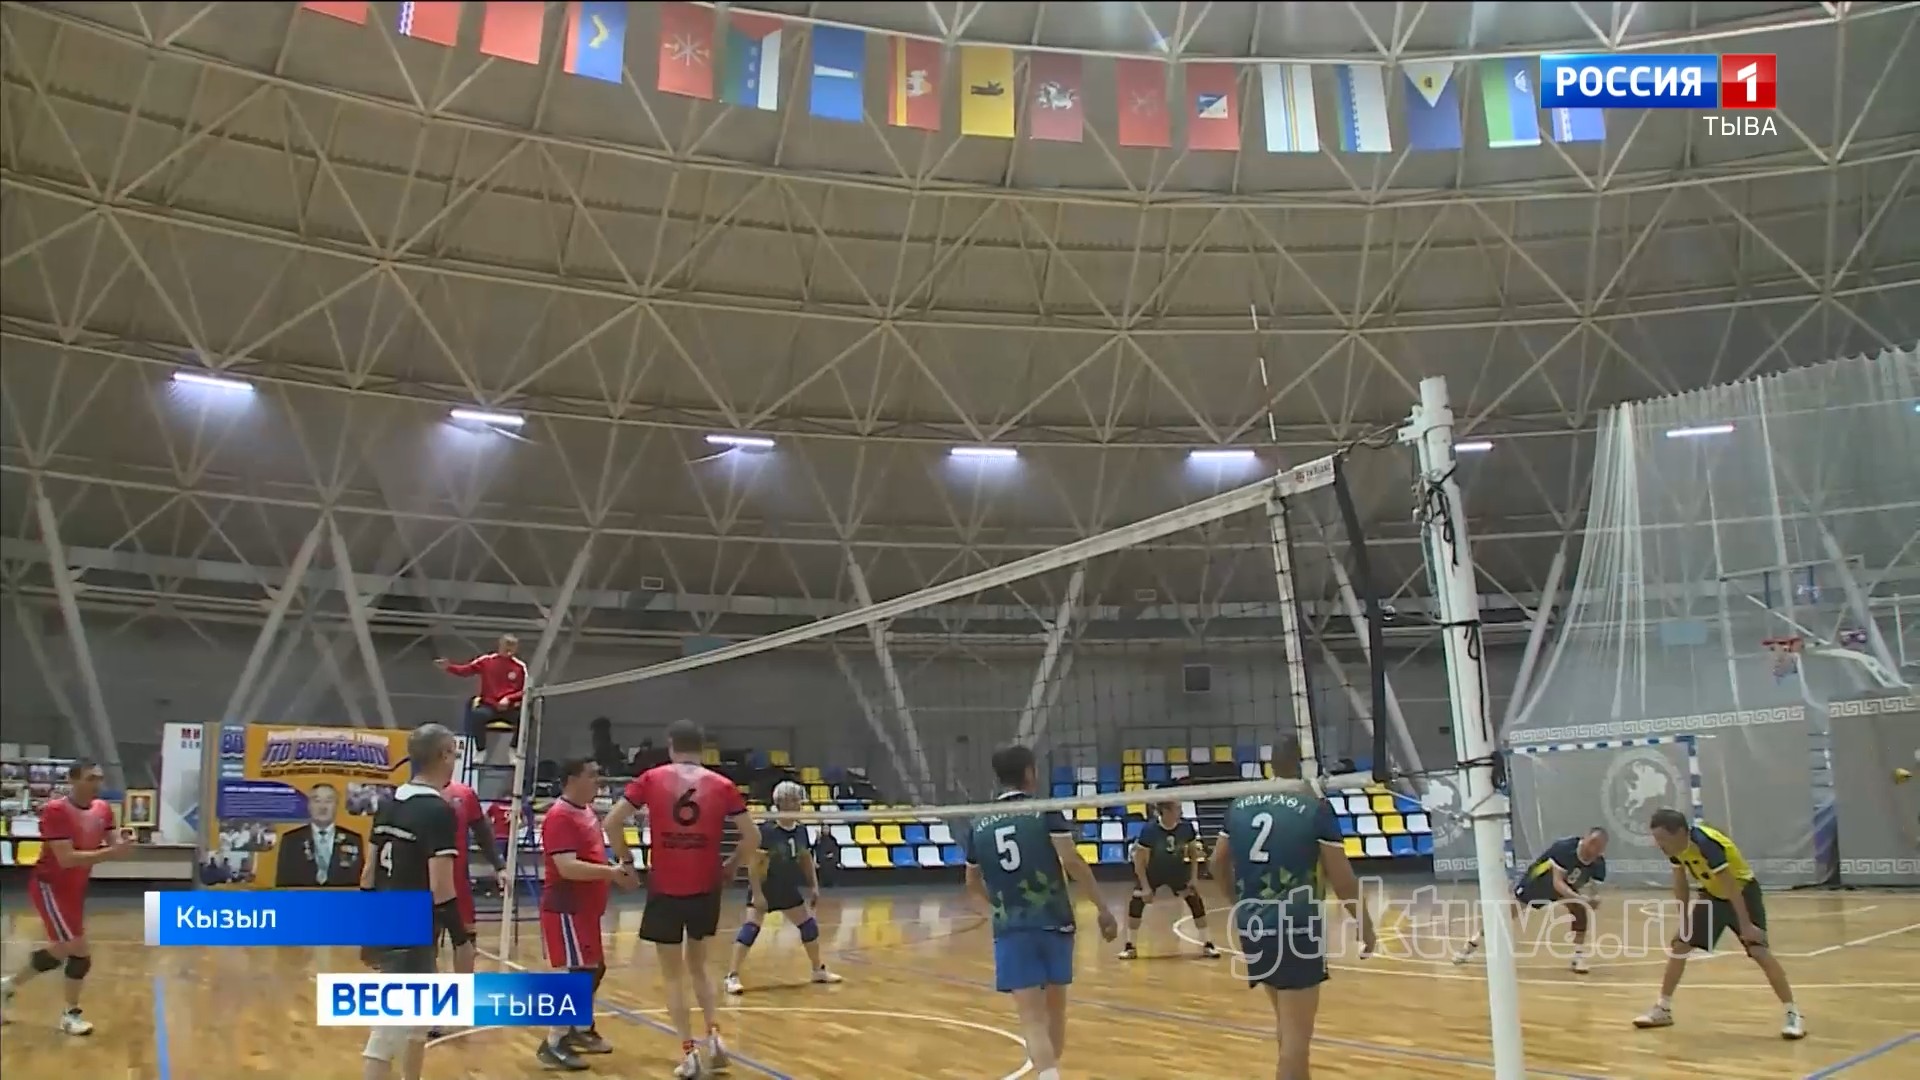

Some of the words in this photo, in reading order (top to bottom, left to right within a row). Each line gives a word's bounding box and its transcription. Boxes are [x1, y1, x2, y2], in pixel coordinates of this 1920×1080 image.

[672, 788, 700, 826] 6
[788, 836, 797, 858] 1
[994, 825, 1021, 871] 5
[1249, 812, 1274, 862] 2
[380, 840, 393, 878] 4
[1567, 867, 1582, 885] 8
